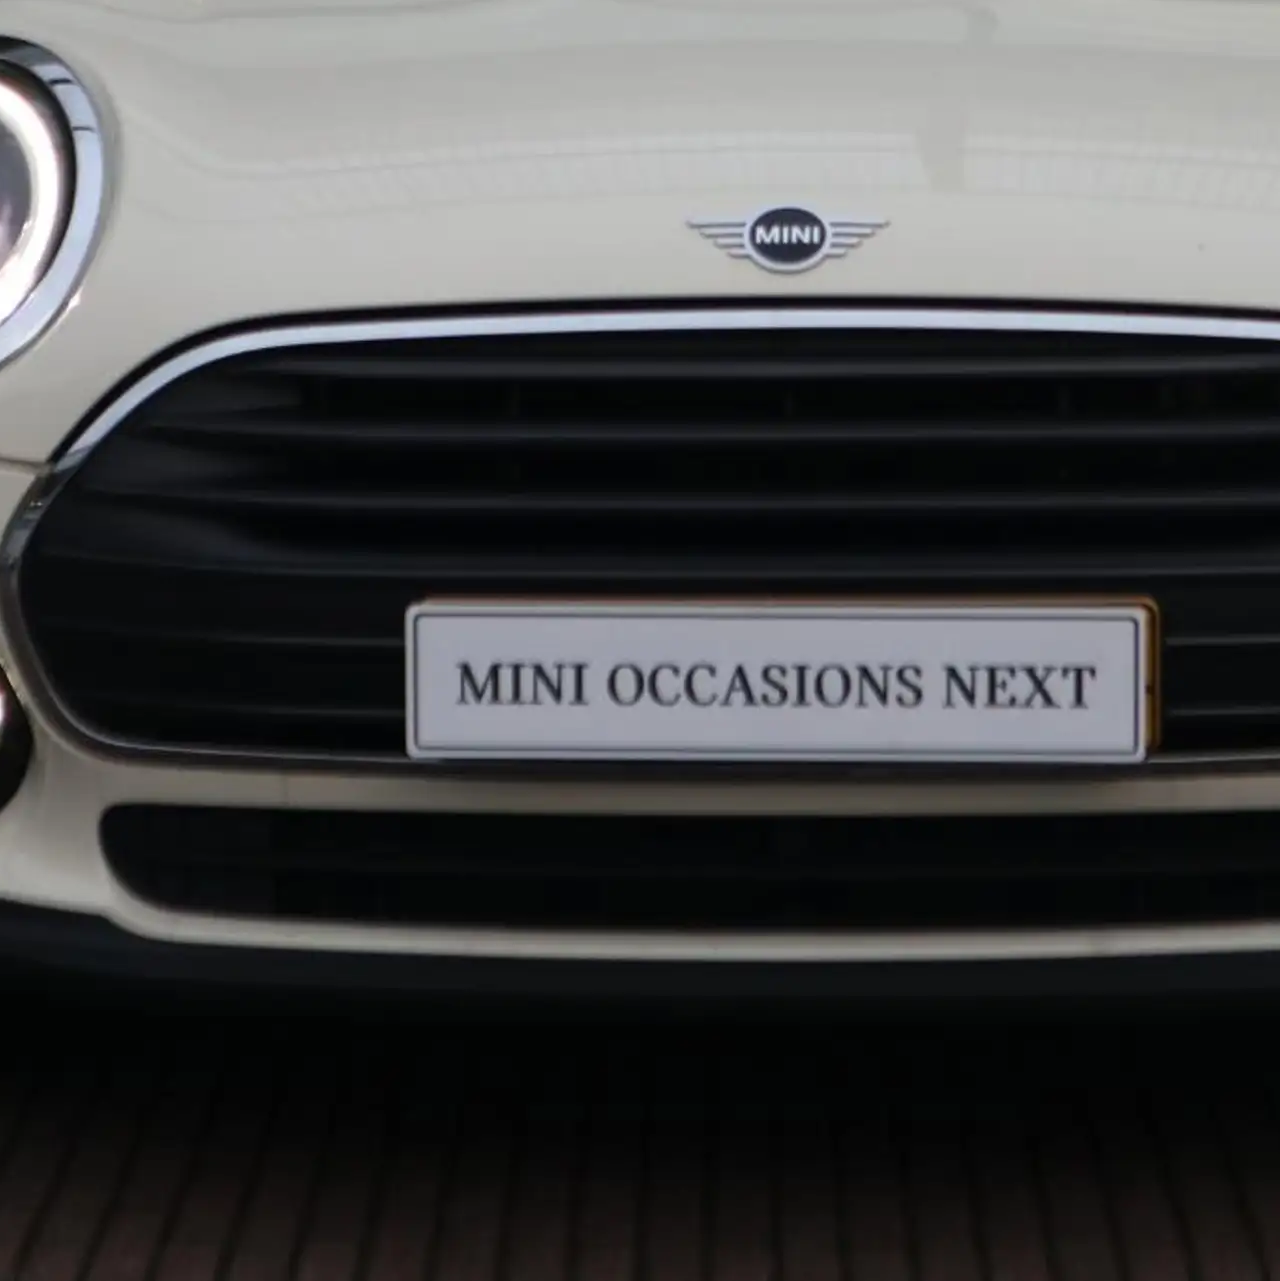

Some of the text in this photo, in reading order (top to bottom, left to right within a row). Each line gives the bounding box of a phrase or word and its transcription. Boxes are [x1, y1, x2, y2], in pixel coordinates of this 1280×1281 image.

[754, 224, 820, 245] MINI
[457, 661, 1097, 710] MINI OCCASIONS NEXT
